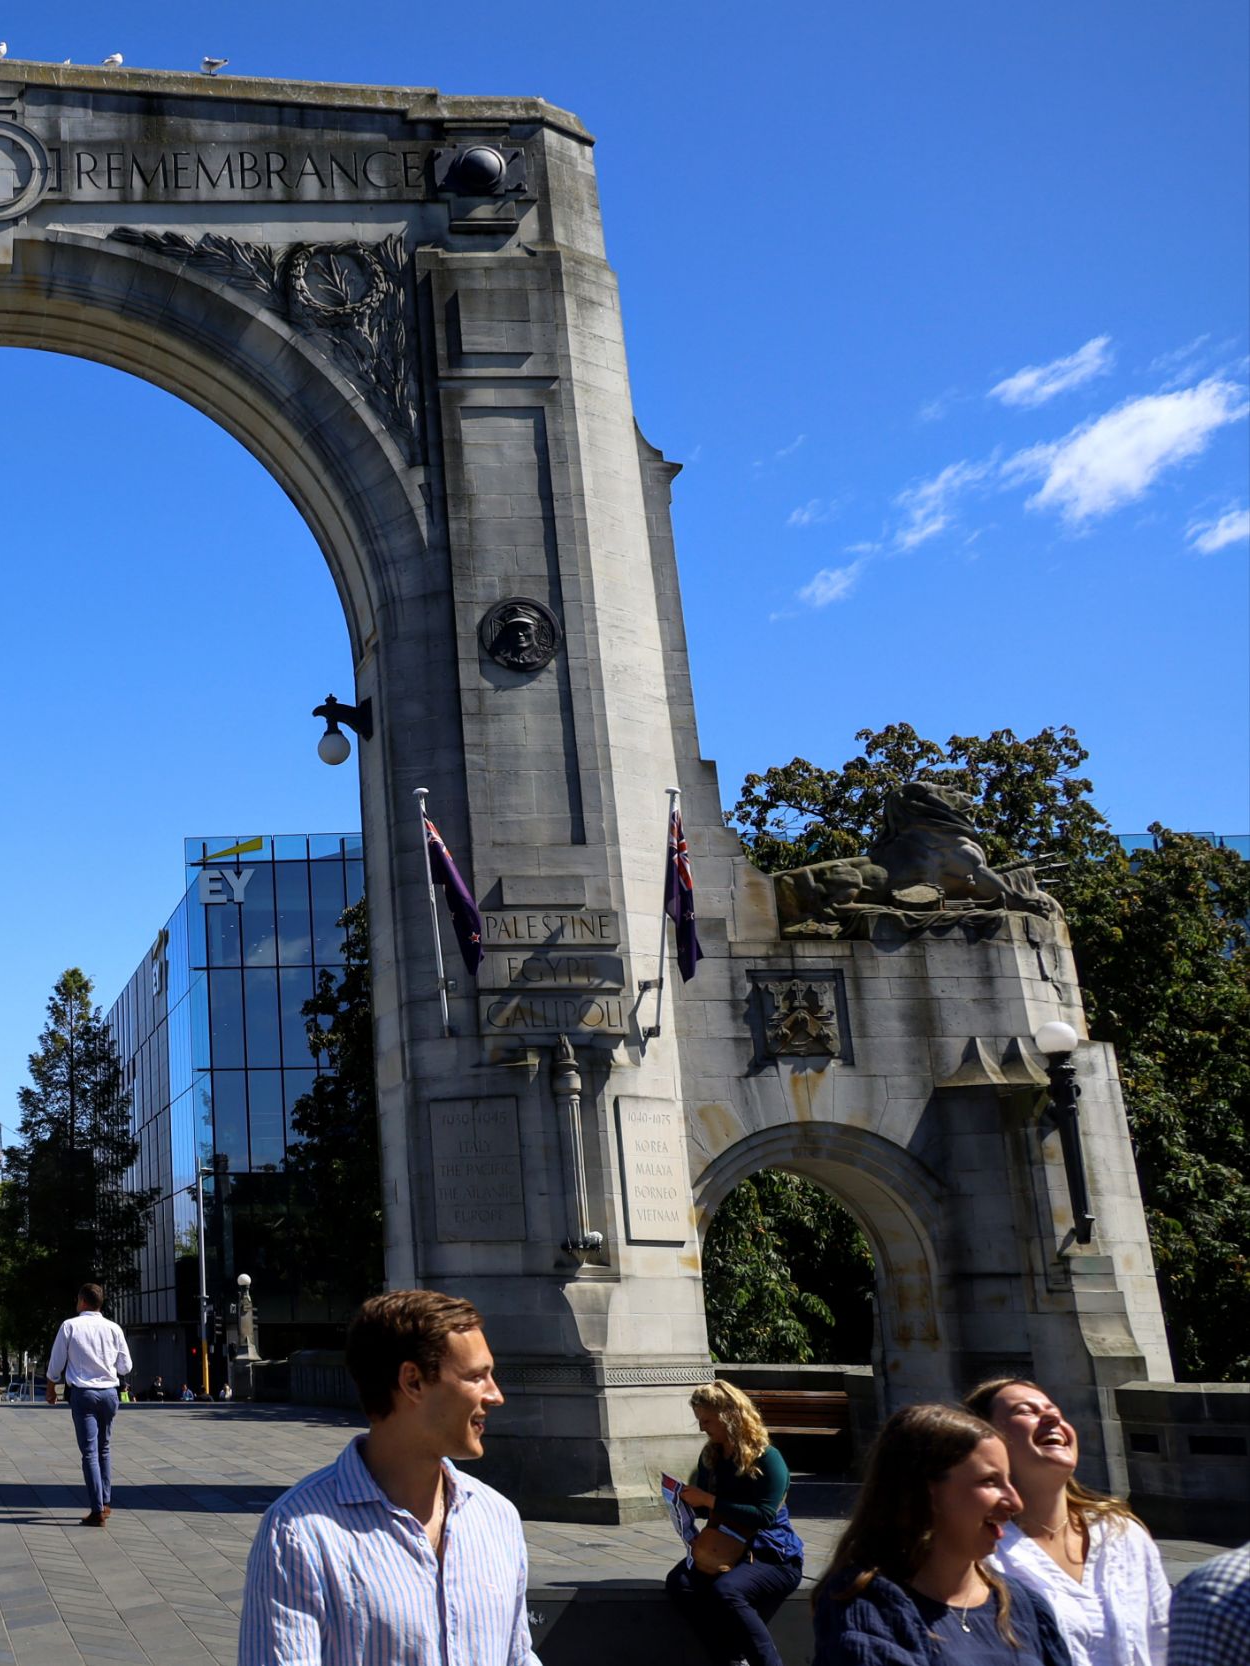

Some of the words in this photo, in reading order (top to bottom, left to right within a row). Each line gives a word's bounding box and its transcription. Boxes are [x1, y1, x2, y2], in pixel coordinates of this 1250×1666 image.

[76, 149, 423, 191] REMEMBRANCE
[199, 869, 255, 904] EY
[485, 915, 611, 939] PALESTINE
[507, 957, 594, 983] EGYPT
[486, 1000, 623, 1028] GALLIPOLI
[458, 1140, 492, 1153] ITALY
[634, 1139, 669, 1153] KOREA
[440, 1164, 461, 1177] THE
[467, 1162, 514, 1177] PACIFIC
[635, 1163, 673, 1176] MALAYA
[438, 1187, 458, 1201] THE
[634, 1186, 677, 1200] BORNEO
[454, 1208, 504, 1224] EUROPE
[636, 1209, 679, 1223] VIETNAM
